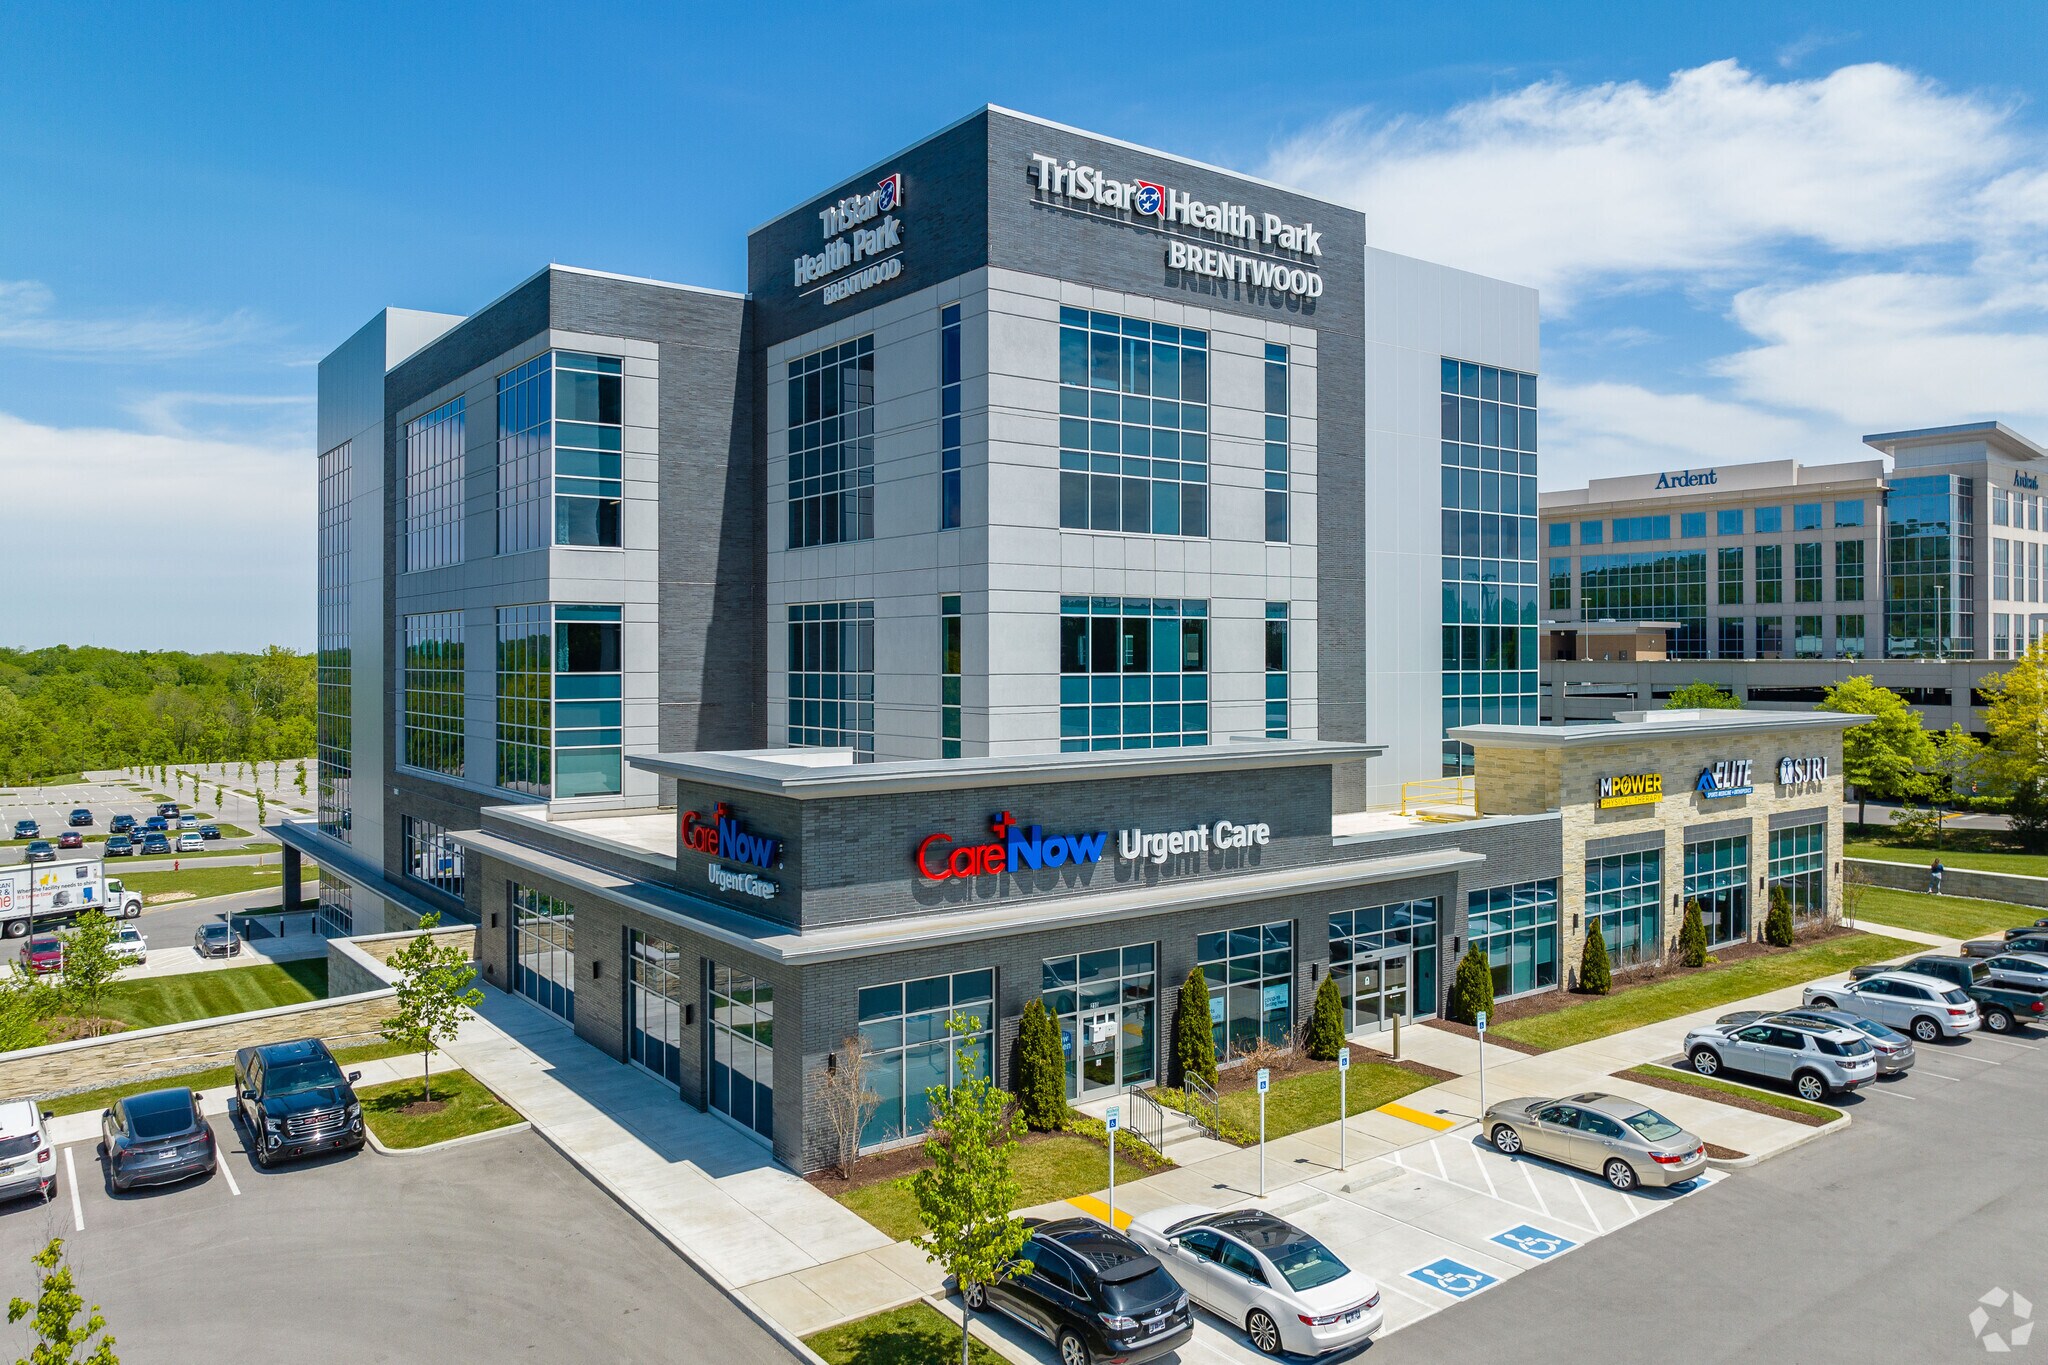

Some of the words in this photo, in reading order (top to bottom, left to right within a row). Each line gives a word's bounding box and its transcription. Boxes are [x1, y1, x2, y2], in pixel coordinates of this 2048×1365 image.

[819, 190, 881, 239] TriStar
[1032, 152, 1137, 211] TriStar
[1166, 188, 1256, 240] Health
[1262, 212, 1323, 257] Park
[794, 236, 851, 287] Health
[853, 215, 901, 261] Park
[1168, 240, 1324, 298] BRENTWOOD
[823, 258, 901, 305] BRENTWOOD
[1655, 468, 1718, 490] Ardent
[1600, 773, 1662, 797] MPOWER
[1712, 759, 1753, 789] ELITE
[1795, 756, 1828, 783] SJRI
[1603, 797, 1631, 806] PHYSICAL
[1118, 823, 1209, 865] Urgent
[1212, 819, 1271, 850] Care
[708, 863, 745, 891] Urgent
[745, 874, 775, 900] Care
